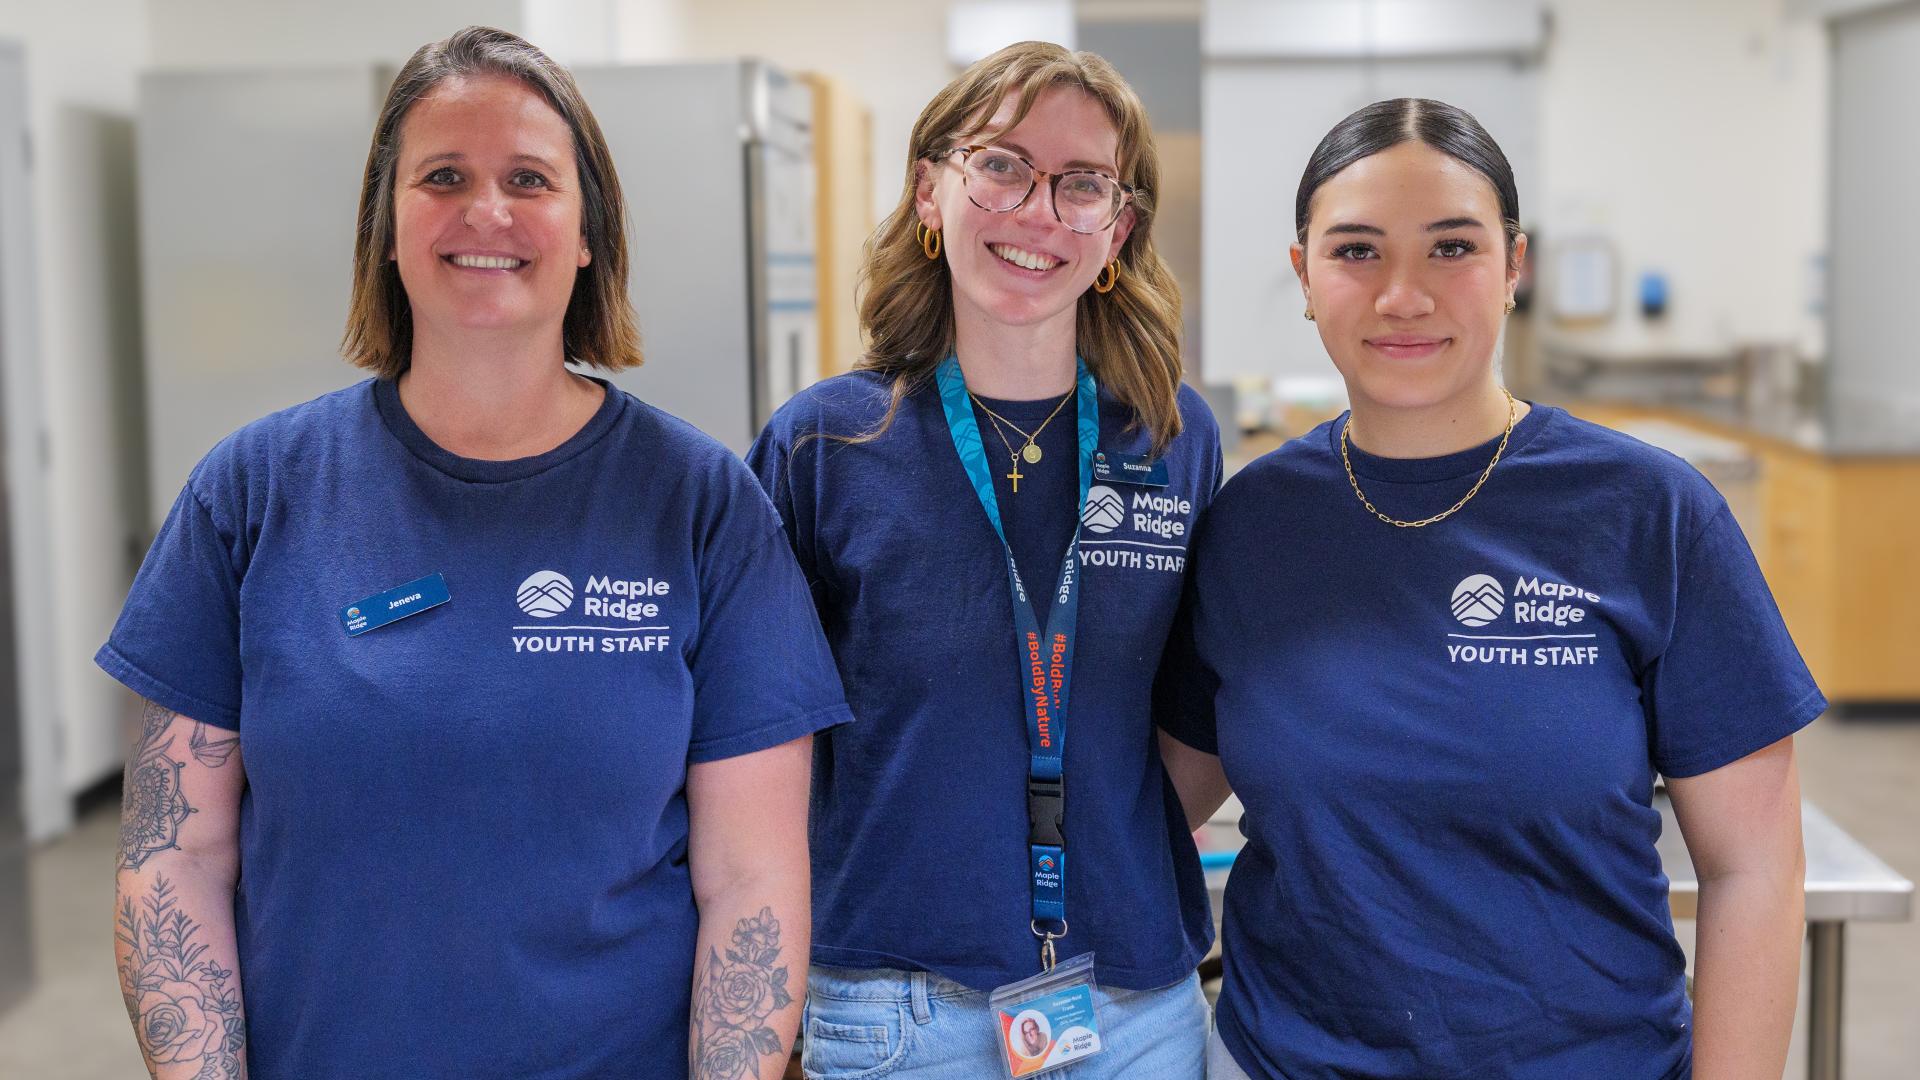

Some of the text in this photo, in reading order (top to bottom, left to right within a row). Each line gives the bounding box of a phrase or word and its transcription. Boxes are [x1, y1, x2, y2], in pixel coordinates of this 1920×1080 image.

[1123, 462, 1152, 473] Suzanna
[1132, 492, 1191, 516] Maple
[1134, 513, 1185, 539] Ridge
[1079, 550, 1186, 573] YOUTH STAFF
[585, 575, 670, 599] Maple
[1059, 559, 1075, 604] Ridge
[1514, 576, 1601, 603] Maple
[388, 593, 422, 609] Jeneva
[585, 598, 659, 622] Ridge
[1515, 600, 1585, 627] Ridge
[512, 636, 670, 653] YOUTH STAFF
[1448, 645, 1599, 666] YOUTH STAFF
[1027, 631, 1051, 748] #BoldByNature
[1035, 872, 1060, 880] Maple
[1036, 879, 1059, 888] Ridge
